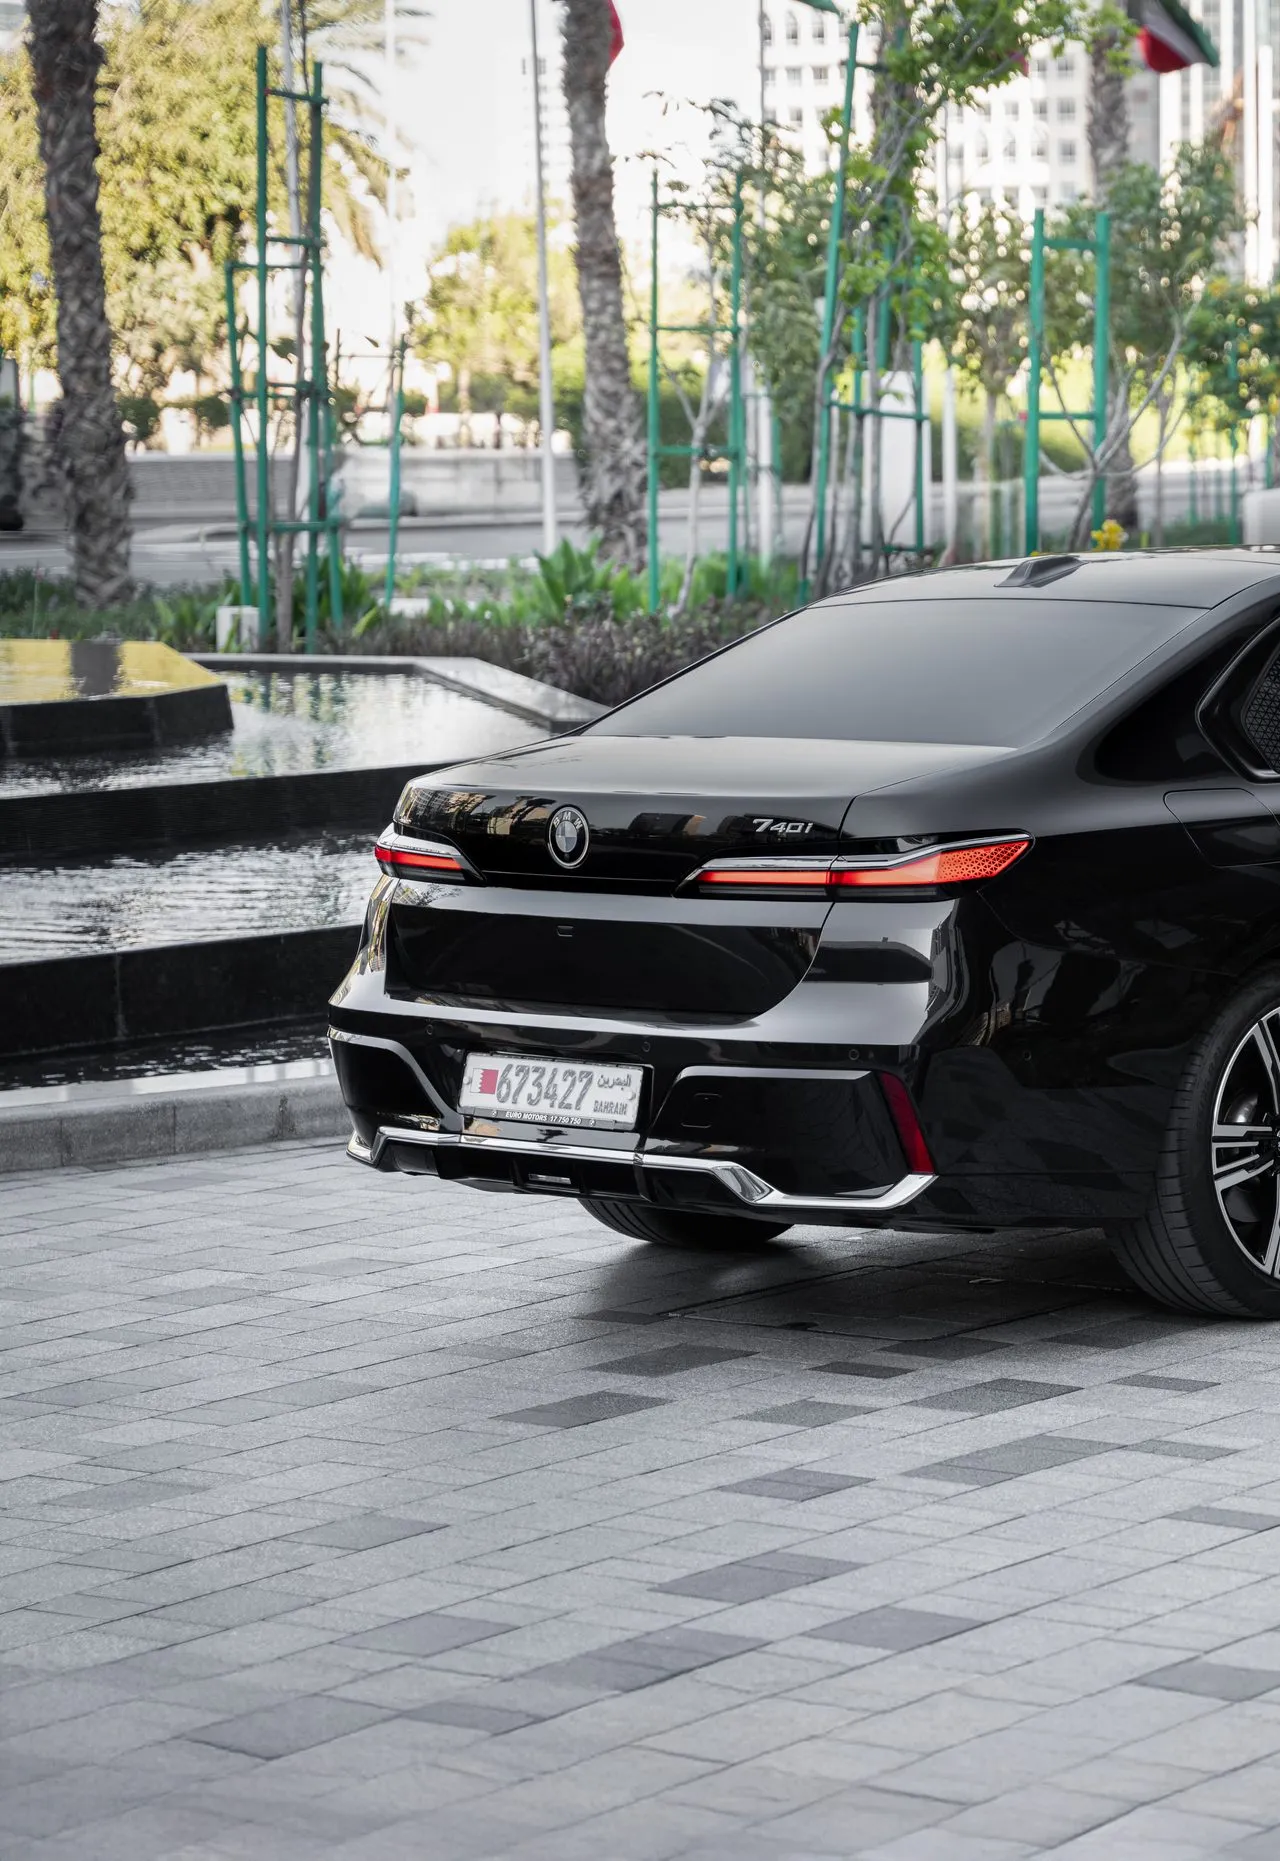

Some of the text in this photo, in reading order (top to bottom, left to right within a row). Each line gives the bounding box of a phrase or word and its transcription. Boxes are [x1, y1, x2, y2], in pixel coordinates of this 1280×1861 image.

[553, 811, 583, 829] BMW
[752, 818, 813, 833] 740i
[496, 1063, 594, 1111] 673427
[597, 1073, 631, 1091] البحرين
[593, 1099, 628, 1115] BAHRAIN
[505, 1111, 522, 1119] EURO
[522, 1112, 548, 1121] MOTORS
[558, 1116, 569, 1124] 750
[570, 1117, 582, 1125] 750
